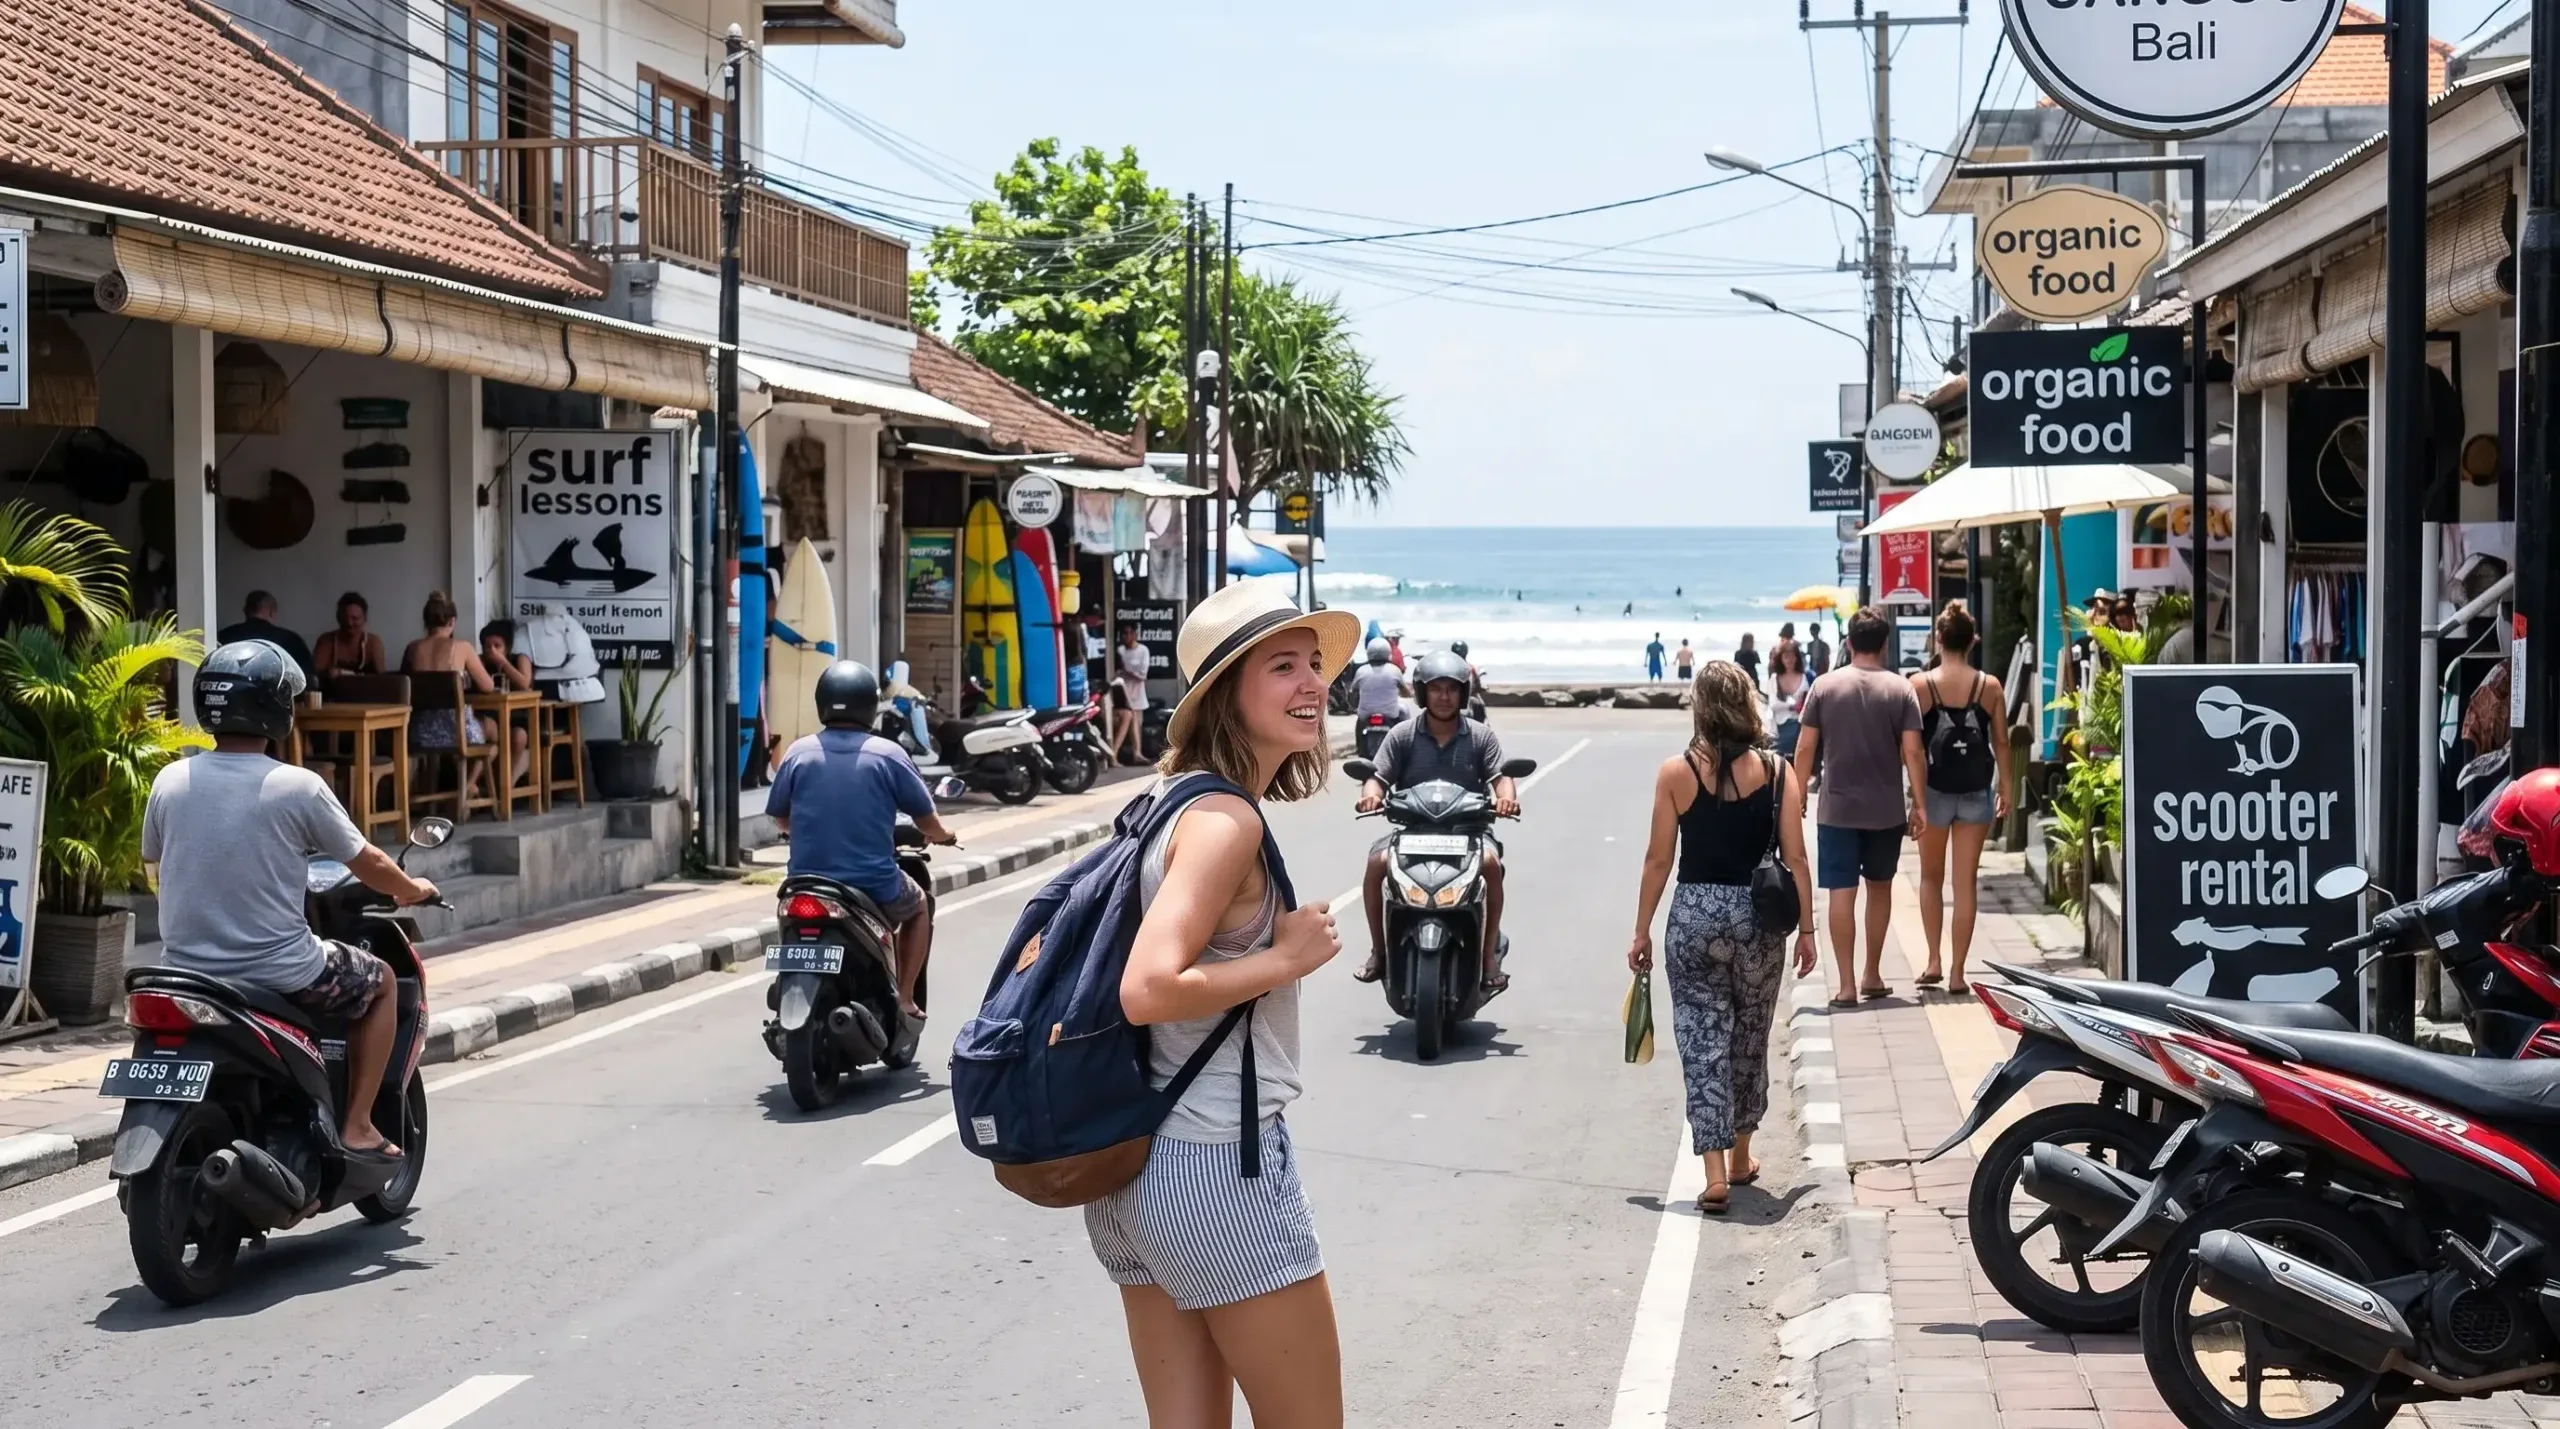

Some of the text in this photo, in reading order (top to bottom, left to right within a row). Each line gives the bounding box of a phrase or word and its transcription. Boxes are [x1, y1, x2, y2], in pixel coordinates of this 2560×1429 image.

[2132, 20, 2216, 62] Bali
[1993, 217, 2142, 260] organic
[2027, 262, 2116, 297] food
[1981, 355, 2172, 410] organic
[2019, 411, 2132, 456] food
[527, 436, 652, 485] surf
[520, 483, 663, 517] lessons
[2153, 779, 2338, 842] scooter
[2181, 845, 2309, 906] rental
